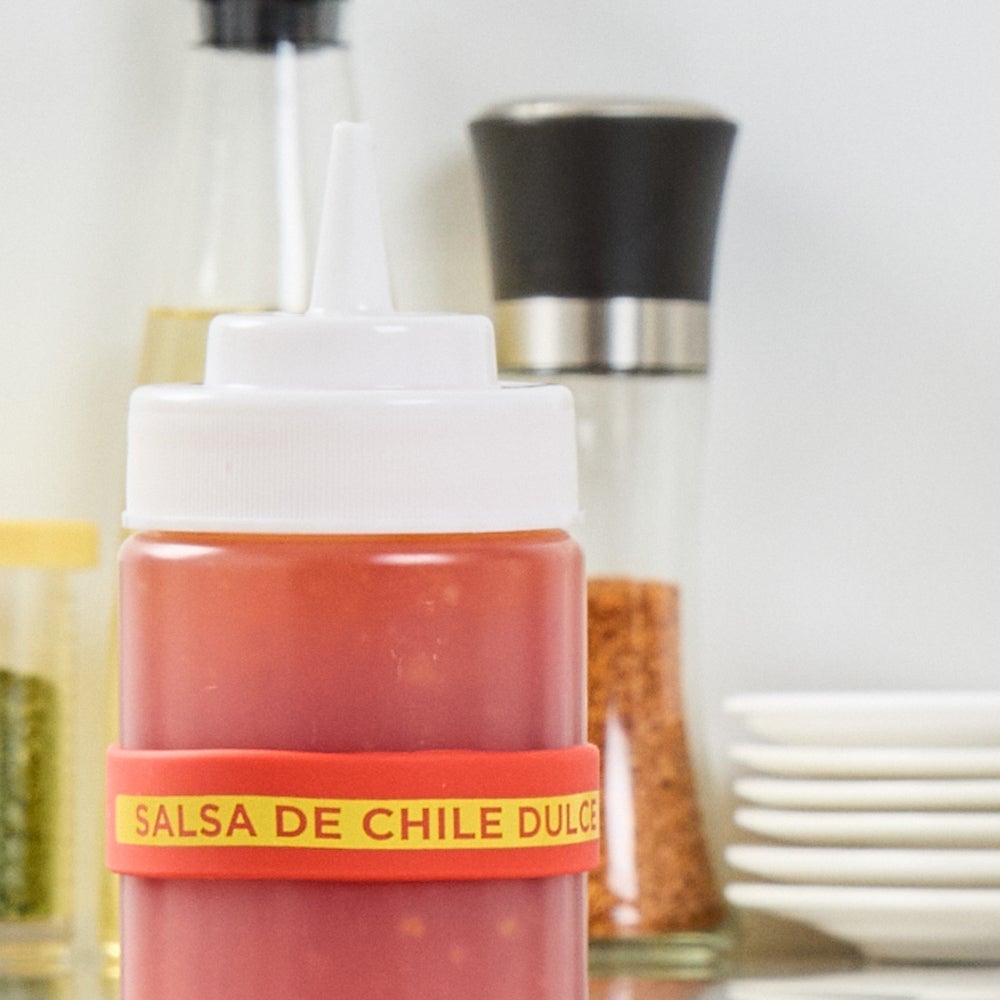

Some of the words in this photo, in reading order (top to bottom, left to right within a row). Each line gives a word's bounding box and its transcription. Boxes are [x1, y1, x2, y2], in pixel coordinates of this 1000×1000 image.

[135, 803, 257, 838] SALSA
[274, 805, 342, 840] DE
[362, 806, 504, 841] CHILE
[518, 798, 597, 839] DULCE
